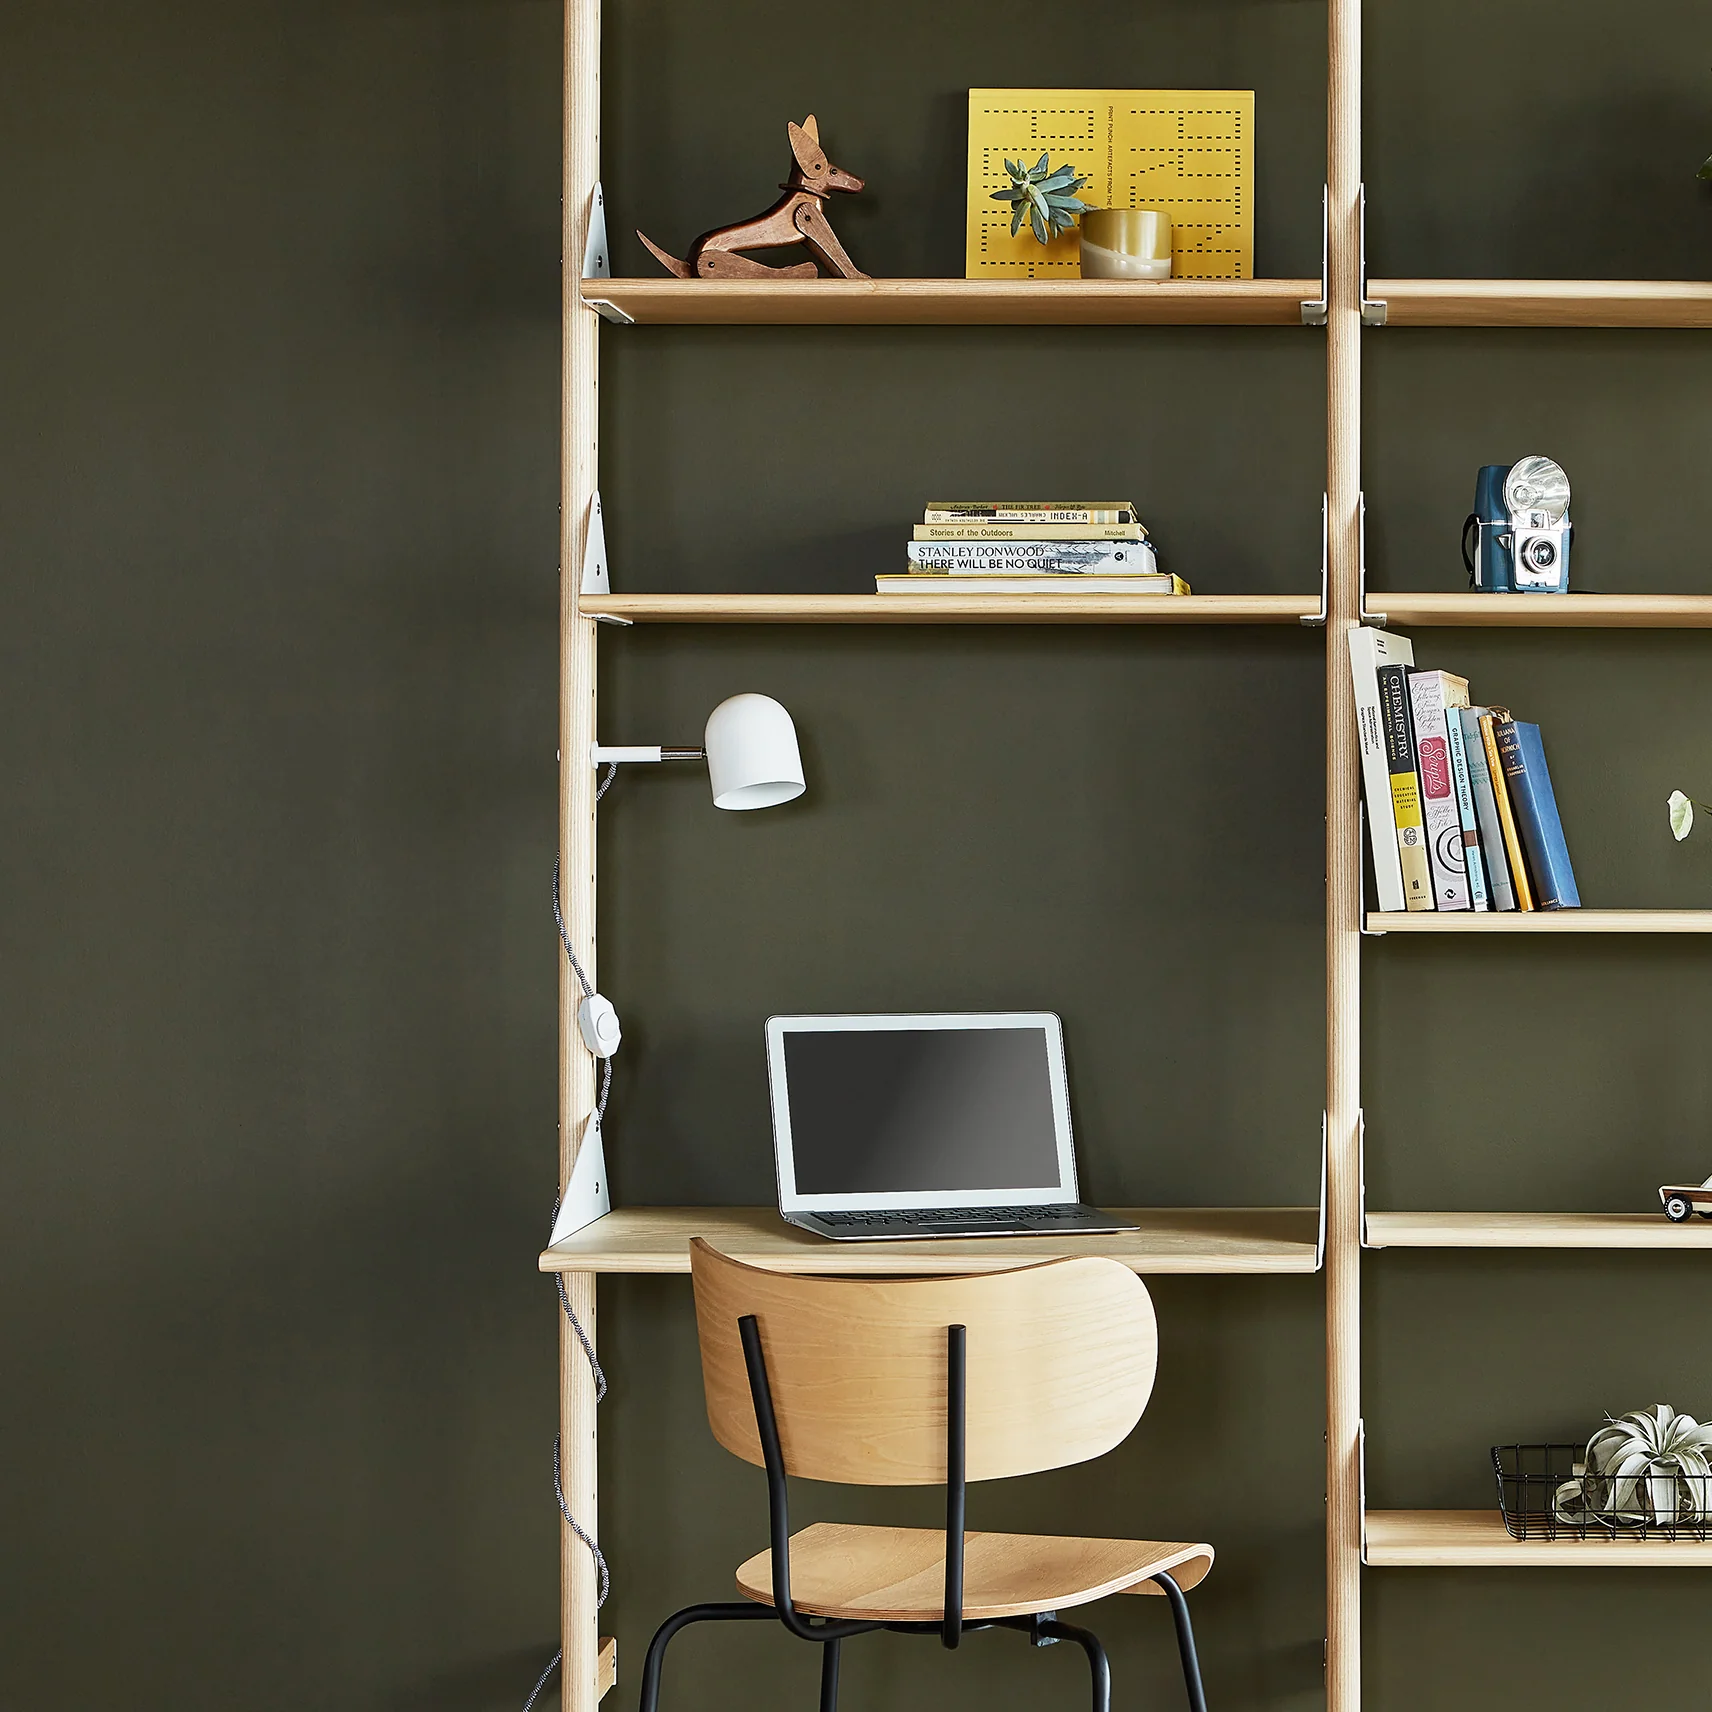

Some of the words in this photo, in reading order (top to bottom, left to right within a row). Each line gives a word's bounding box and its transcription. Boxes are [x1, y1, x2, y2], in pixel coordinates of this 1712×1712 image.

[1050, 512, 1088, 521] INDEX-A
[929, 528, 955, 537] Stories
[956, 528, 965, 537] of
[967, 528, 979, 537] the
[980, 528, 1014, 537] Outdoors
[918, 546, 974, 557] STANLEY
[976, 546, 1045, 557] DONWOOD
[918, 559, 955, 569] THERE
[957, 559, 986, 569] WILL
[988, 559, 1003, 569] BE
[1005, 559, 1025, 569] NO
[1026, 559, 1063, 569] QUIET
[1383, 687, 1393, 732] EXPERIMENTAL
[1389, 735, 1397, 760] SCIENCE
[1390, 675, 1409, 760] CHEMISTRY
[1452, 727, 1462, 757] GRAPHIC
[1419, 740, 1447, 794] Scripts
[1457, 758, 1465, 783] DESIGN
[1460, 785, 1469, 811] THEORY
